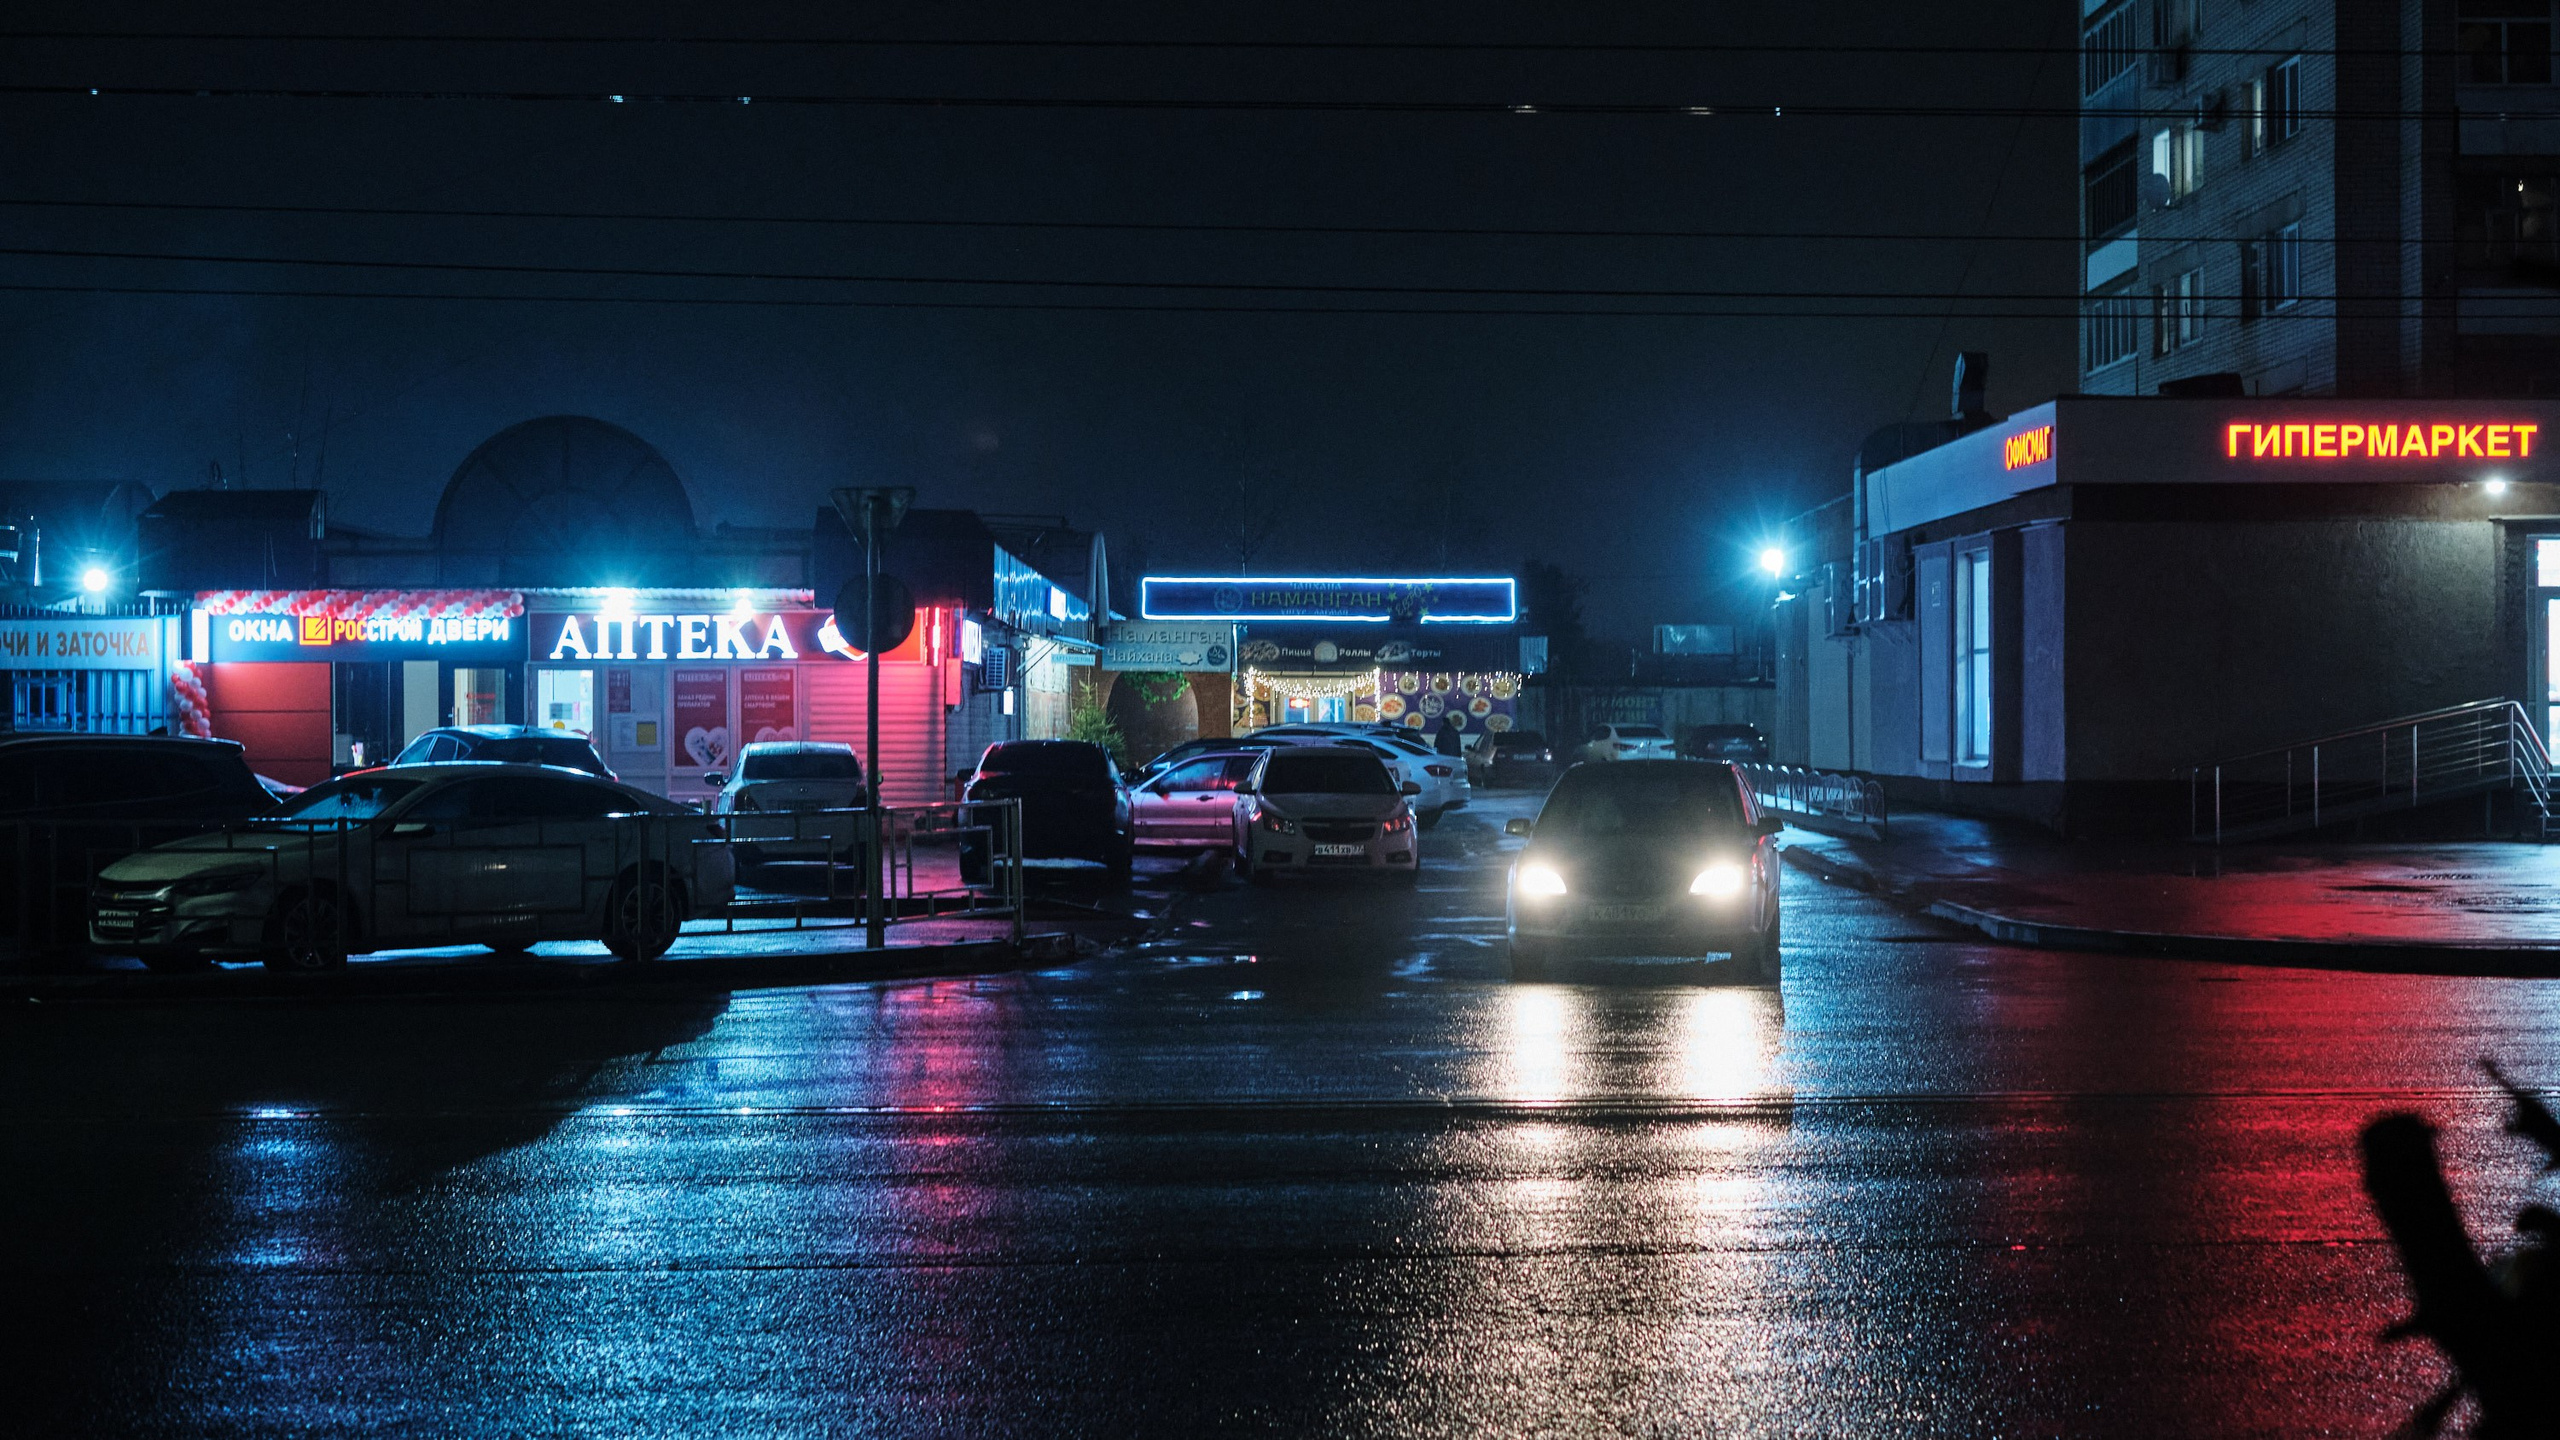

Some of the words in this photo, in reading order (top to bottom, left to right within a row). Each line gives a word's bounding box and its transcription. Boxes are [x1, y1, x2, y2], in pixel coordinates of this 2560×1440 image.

[2005, 425, 2050, 470] ОФИСМАГ
[2228, 424, 2538, 457] ГИПЕРМАРКЕТ
[1251, 590, 1382, 608] НАМАНГАН
[229, 619, 294, 642] ОКНА
[427, 618, 509, 645] ДВЕРИ
[550, 614, 798, 660] АПТЕКА
[1107, 626, 1227, 645] Наманган
[0, 631, 29, 657] ЧИ
[37, 631, 49, 657] И
[56, 631, 149, 657] ЗАТОЧКА
[1281, 648, 1312, 657] Пицца
[1339, 648, 1371, 657] Роллы
[1411, 648, 1442, 658] Торты
[1107, 648, 1174, 663] Чайхана
